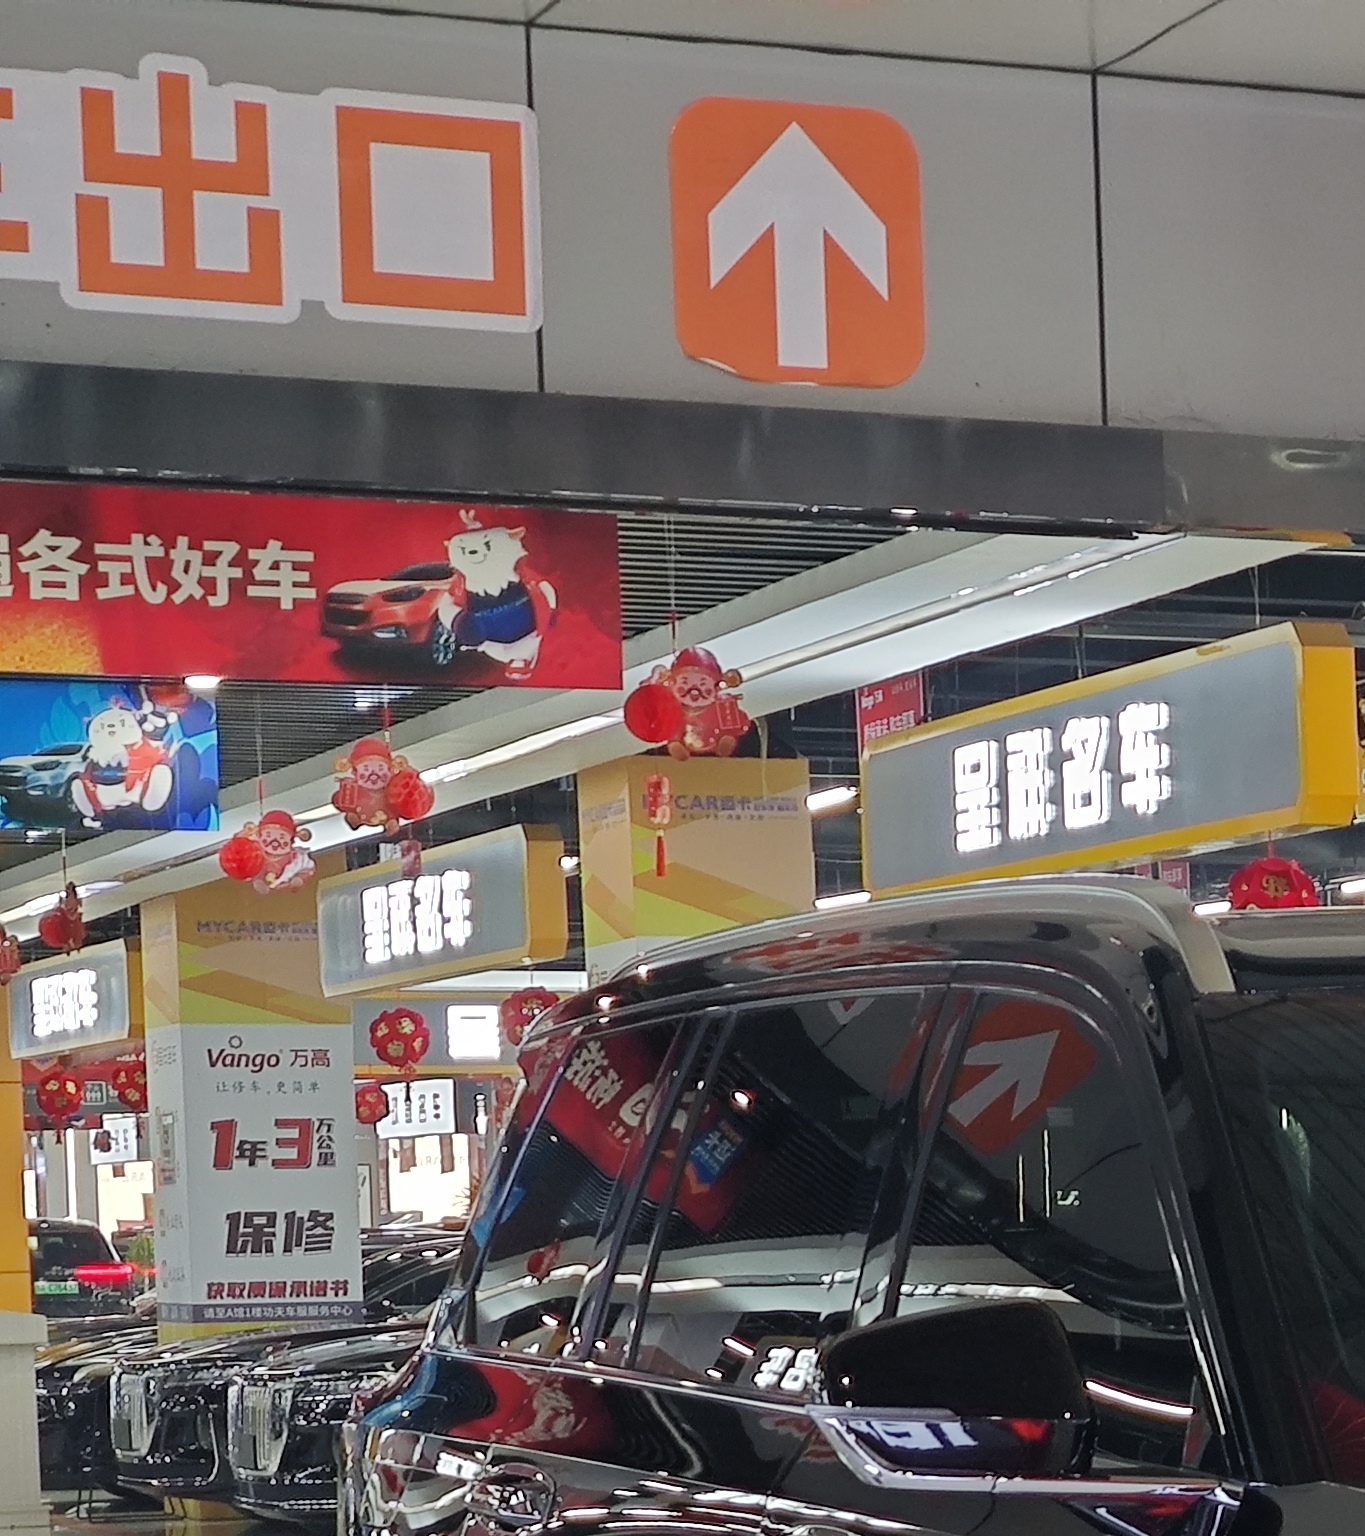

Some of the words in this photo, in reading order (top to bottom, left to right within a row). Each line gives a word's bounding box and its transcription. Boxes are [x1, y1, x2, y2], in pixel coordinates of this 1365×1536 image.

[0, 72, 528, 316] 出口
[0, 528, 318, 611] 各式好车
[952, 701, 1171, 853] 呈祥名车
[206, 1048, 280, 1074] Vango
[288, 1048, 331, 1068] 万高
[224, 1207, 336, 1258] 保修
[206, 1278, 350, 1300] 获取质保承诺书
